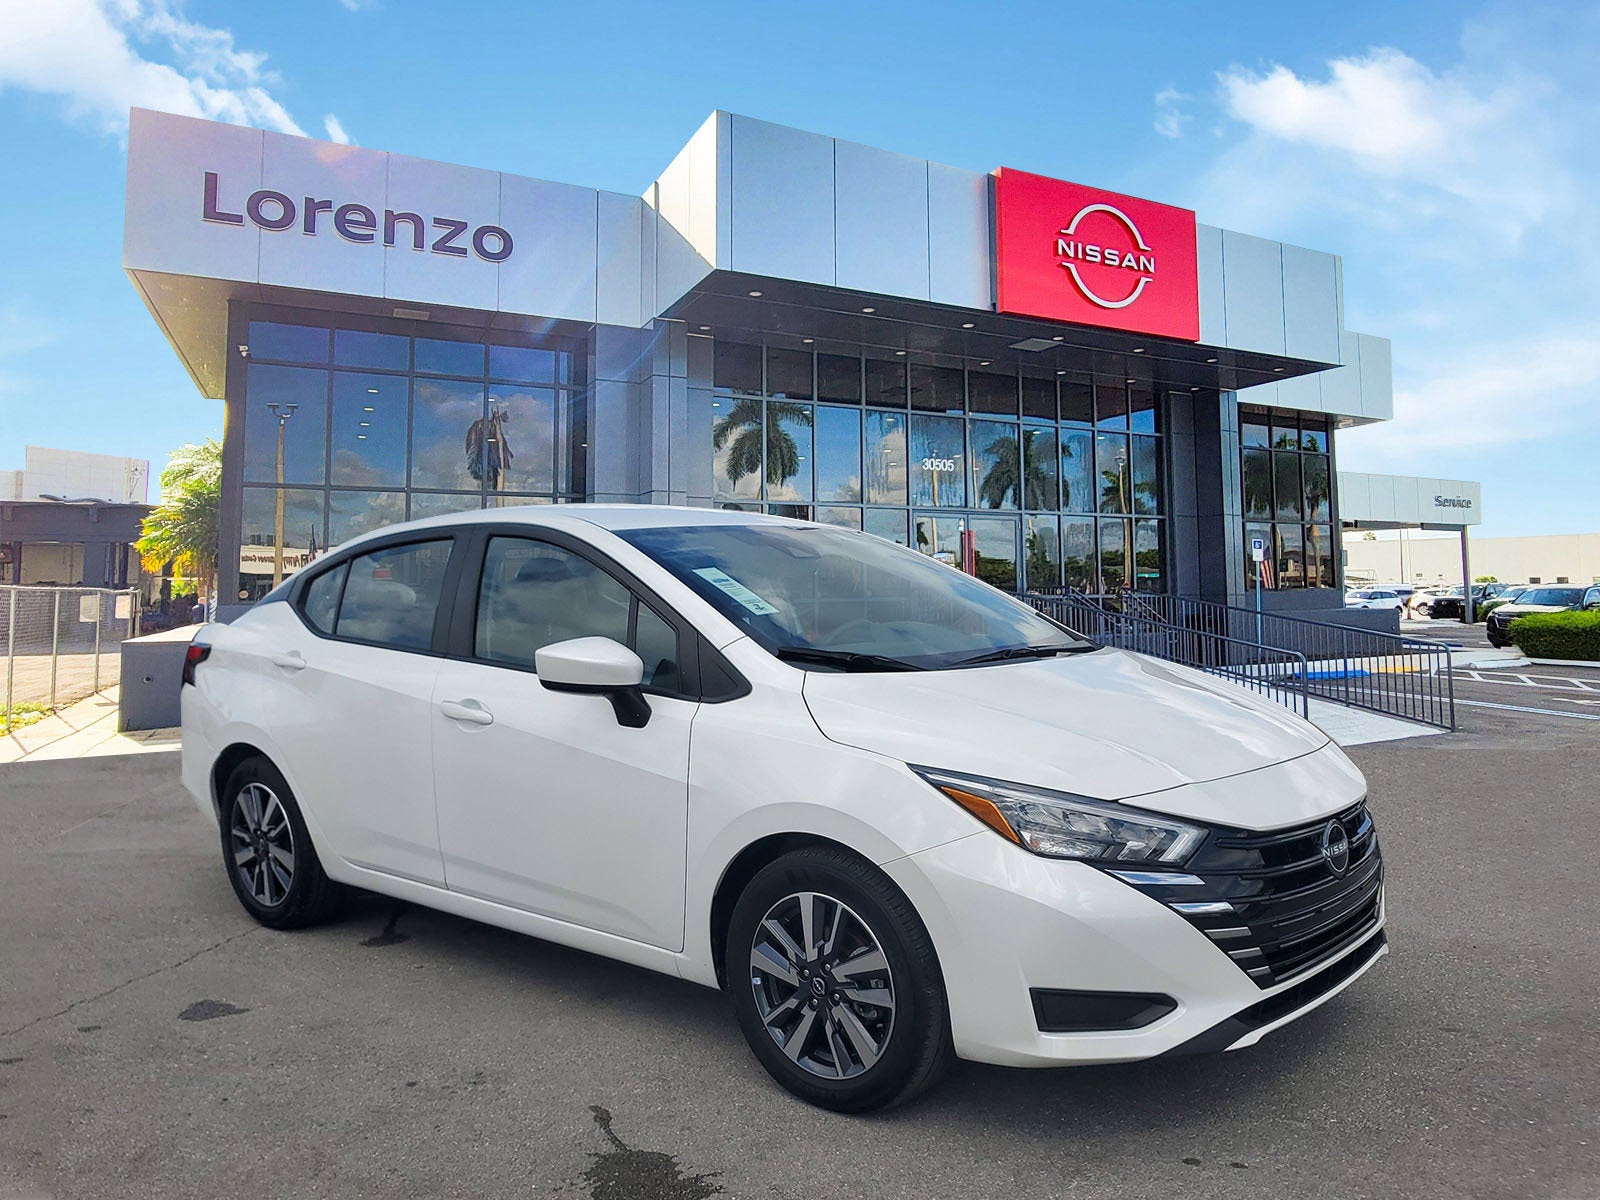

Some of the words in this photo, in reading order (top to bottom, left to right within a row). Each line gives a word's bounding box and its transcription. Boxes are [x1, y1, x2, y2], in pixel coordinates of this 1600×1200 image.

[203, 171, 514, 262] Lorenzo
[1057, 238, 1155, 273] NISSAN
[922, 457, 954, 472] 30505
[1434, 495, 1472, 508] Service
